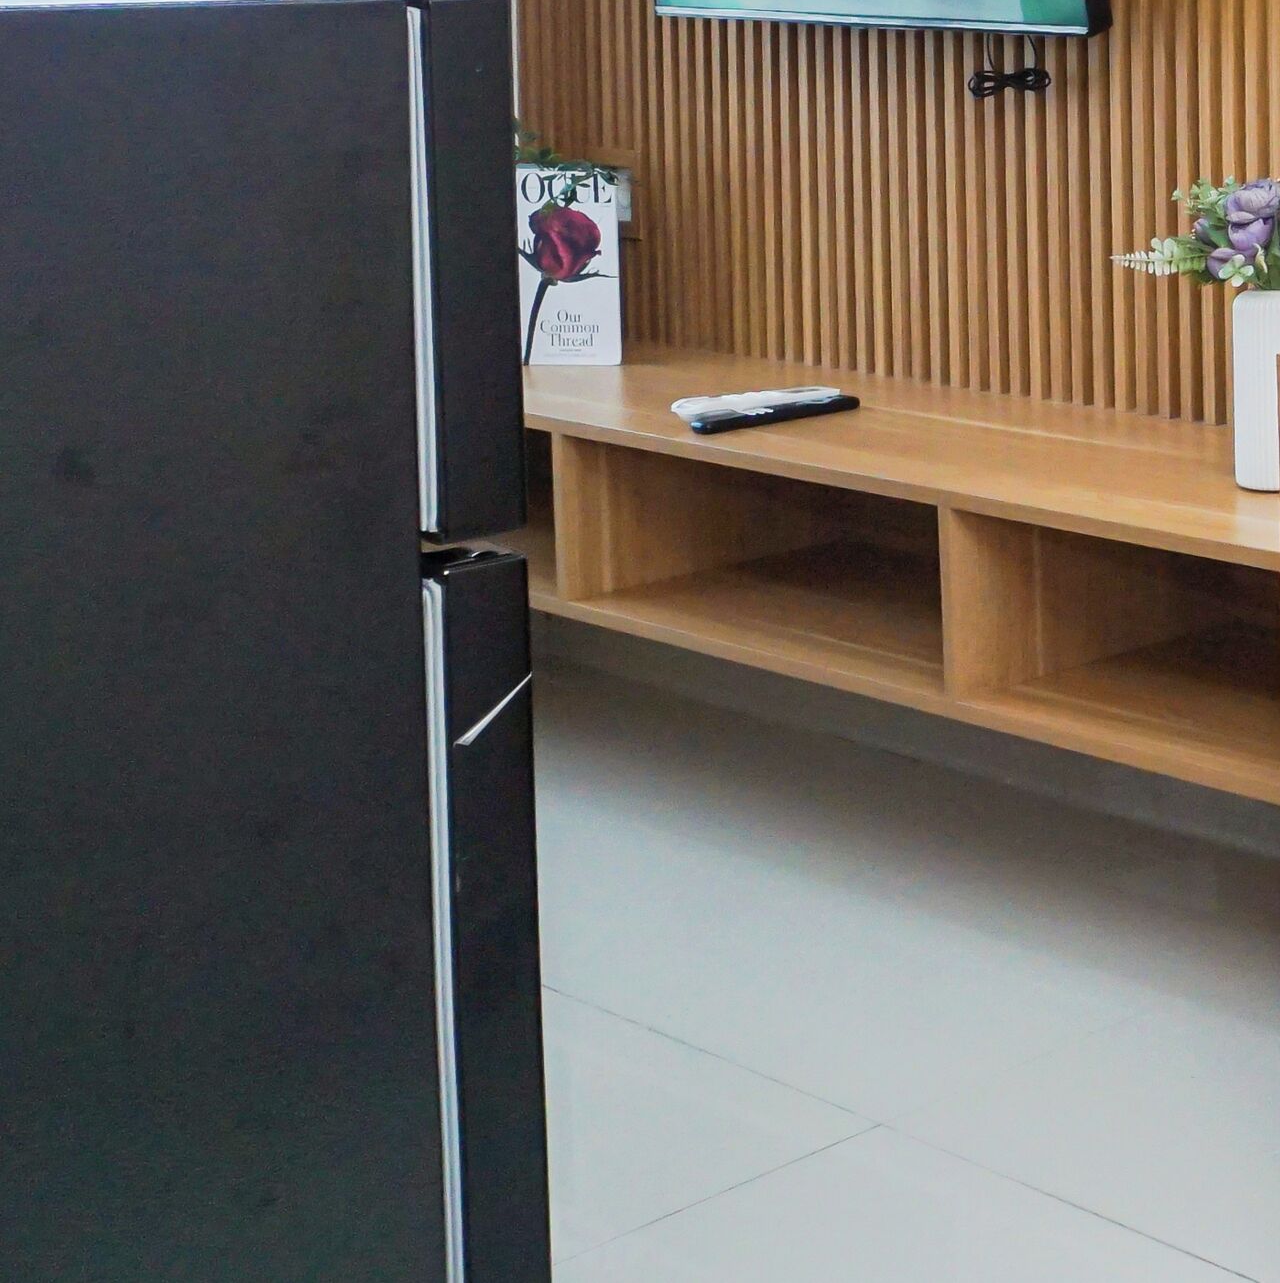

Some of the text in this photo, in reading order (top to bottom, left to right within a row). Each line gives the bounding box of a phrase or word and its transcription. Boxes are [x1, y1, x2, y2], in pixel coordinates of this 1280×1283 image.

[557, 309, 582, 323] Our
[540, 320, 600, 334] Common
[551, 334, 594, 347] Thread
